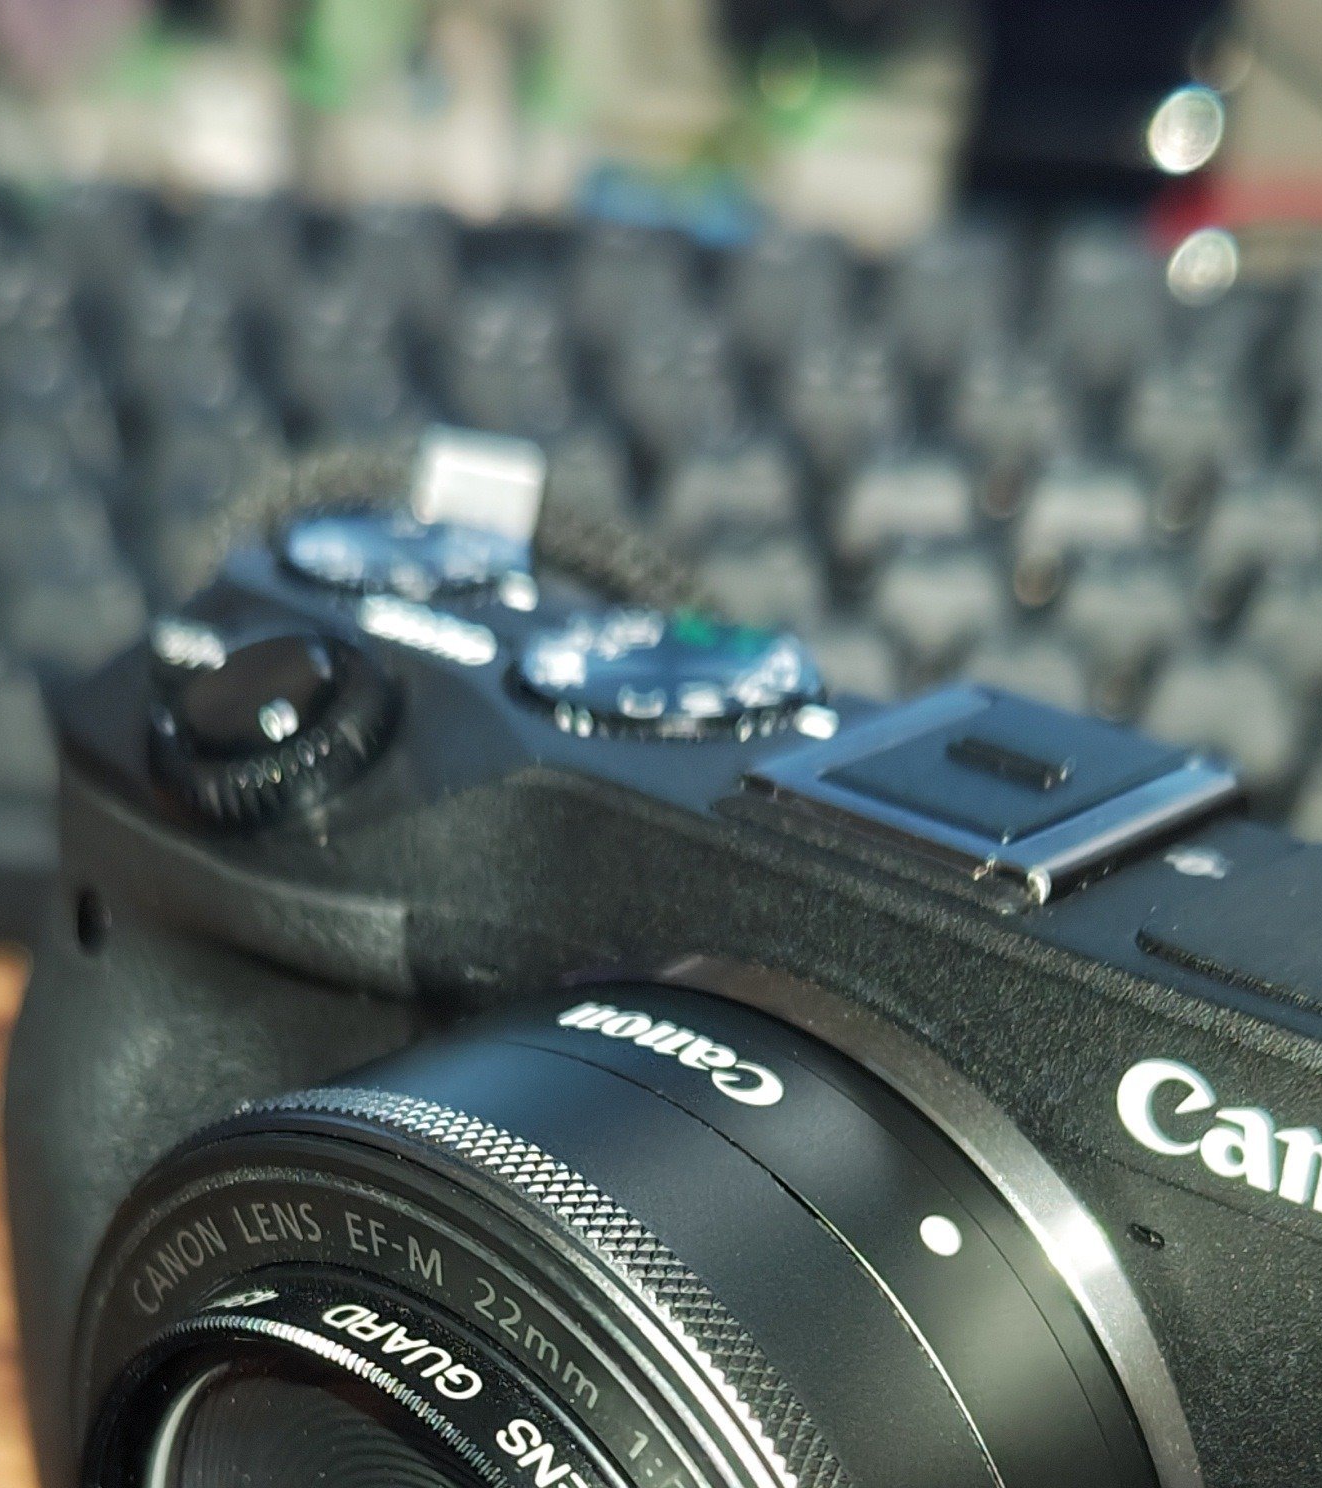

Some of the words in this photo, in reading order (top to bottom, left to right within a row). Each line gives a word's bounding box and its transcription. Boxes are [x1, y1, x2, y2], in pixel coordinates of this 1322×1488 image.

[557, 1002, 784, 1106] Canon
[133, 1216, 227, 1314] CANON
[232, 1202, 322, 1244] LENS
[344, 1211, 444, 1287] EF-M
[474, 1278, 599, 1410] 22mm
[322, 1304, 483, 1401] GUARD
